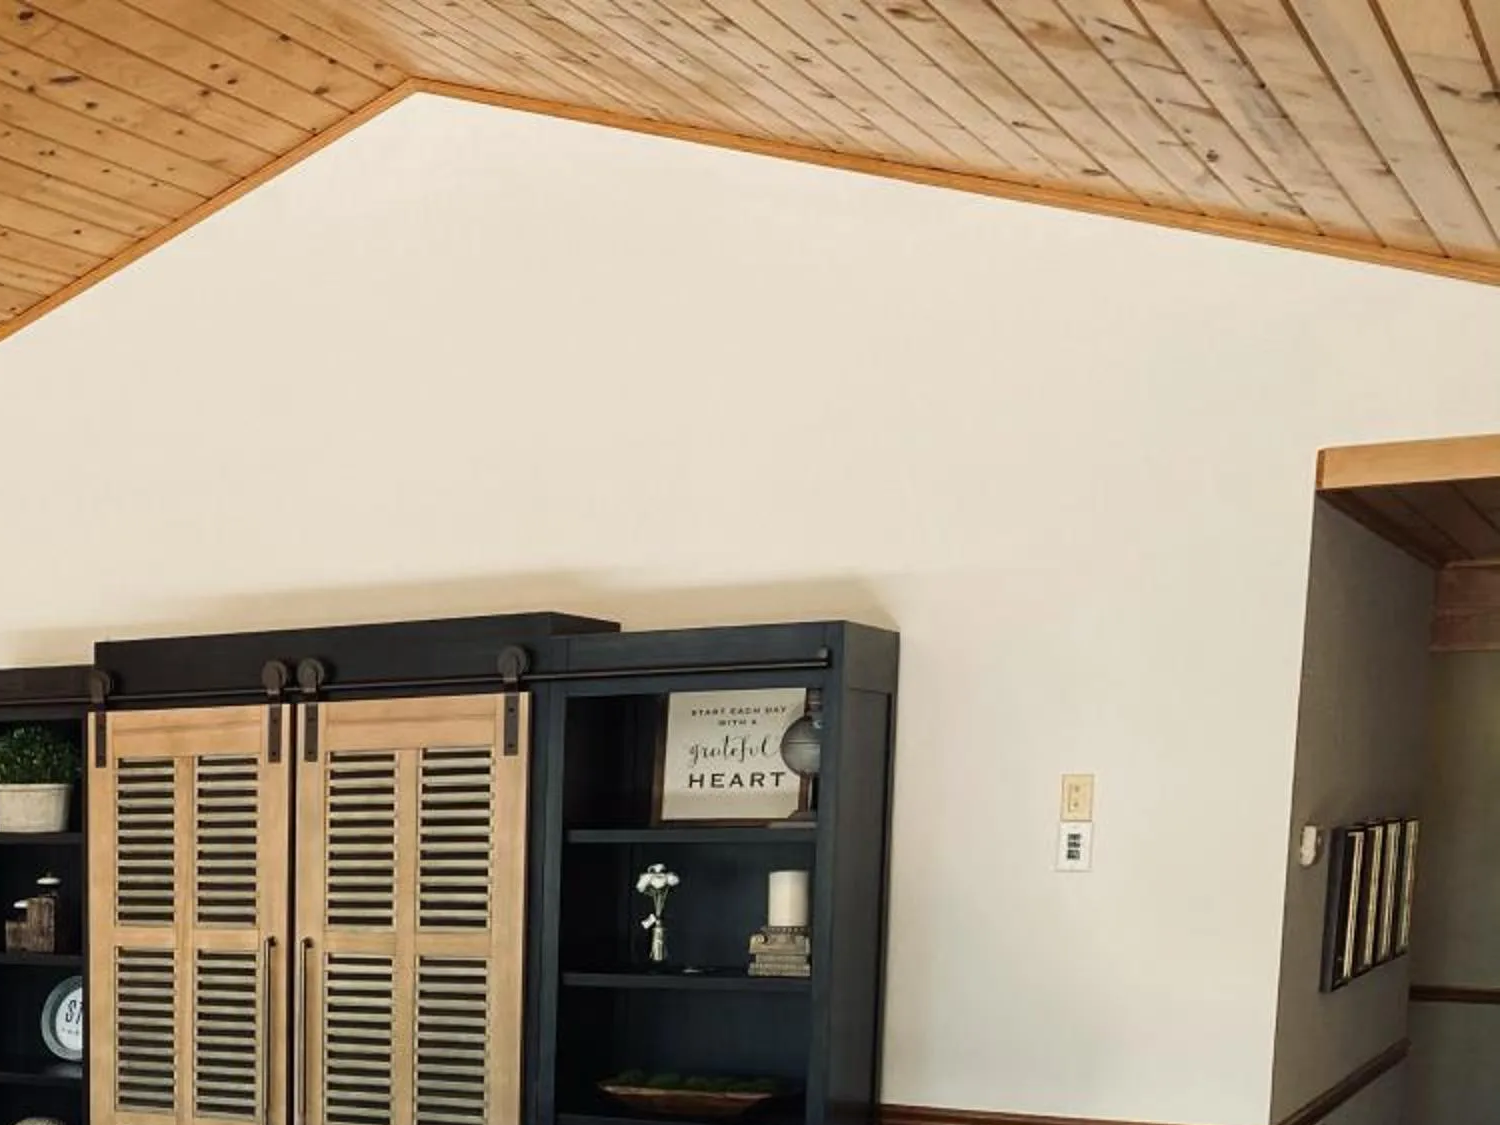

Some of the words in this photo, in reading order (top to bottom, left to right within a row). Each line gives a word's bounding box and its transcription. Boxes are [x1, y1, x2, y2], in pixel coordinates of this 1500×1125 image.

[691, 707, 726, 717] START
[729, 706, 761, 715] EACH
[688, 771, 786, 789] HEART
